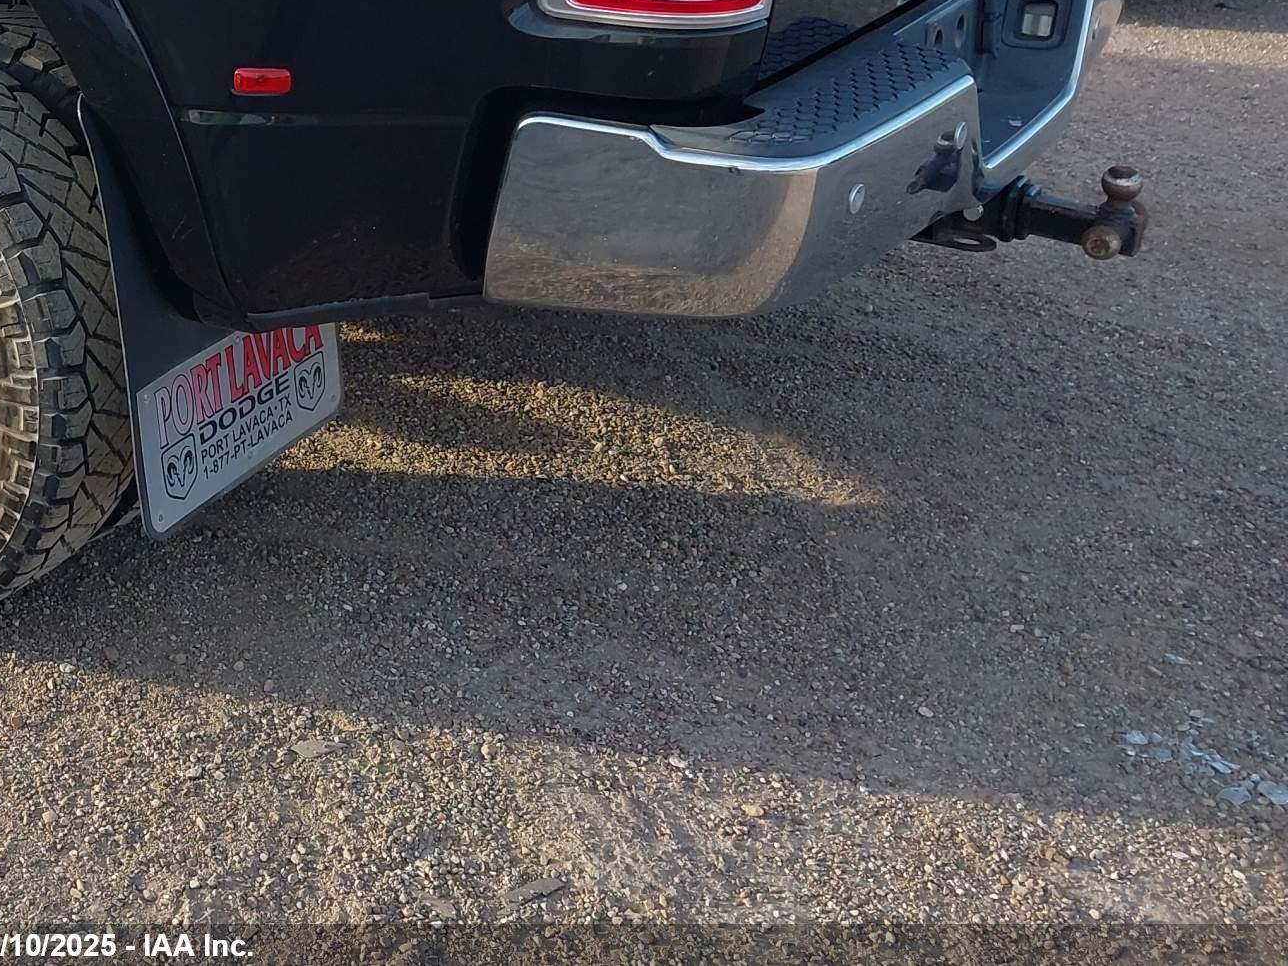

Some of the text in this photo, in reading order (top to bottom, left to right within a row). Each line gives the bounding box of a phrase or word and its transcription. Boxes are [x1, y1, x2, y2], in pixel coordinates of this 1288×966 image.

[153, 323, 324, 450] PORT LAVACA
[198, 371, 290, 446] DODGE
[201, 436, 230, 464] PORT
[203, 413, 293, 480] 1-877-PT-LAVACA
